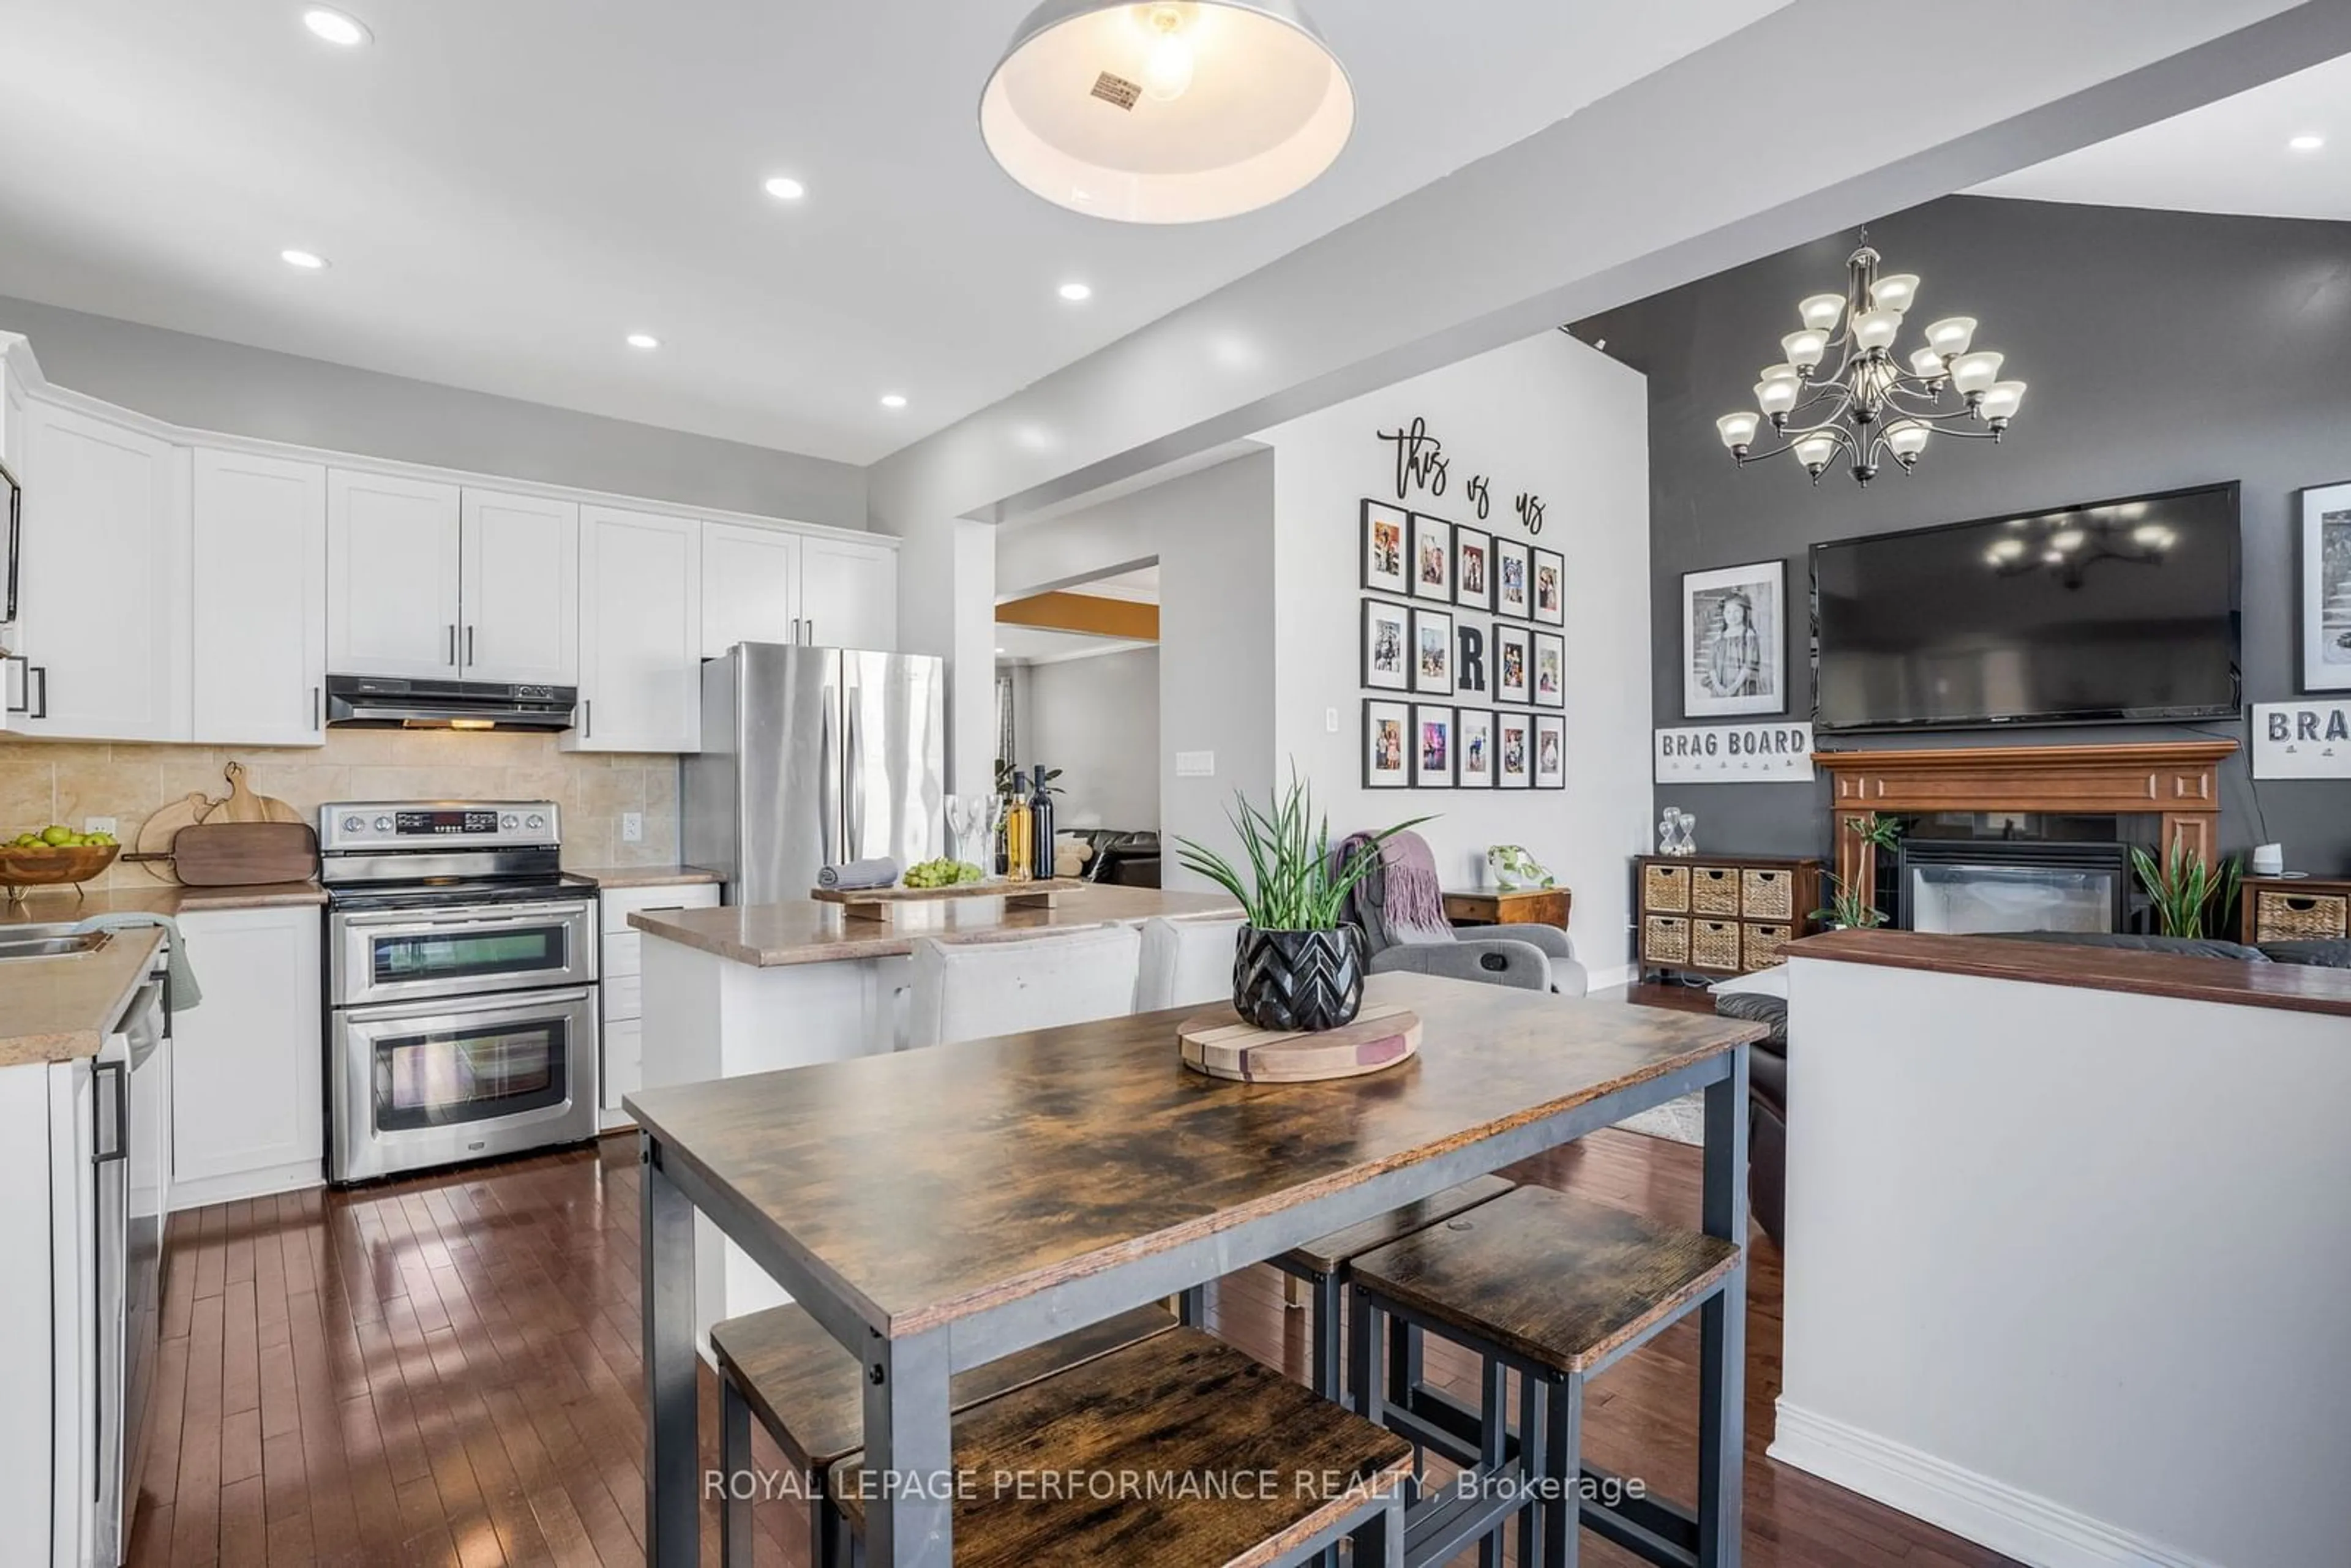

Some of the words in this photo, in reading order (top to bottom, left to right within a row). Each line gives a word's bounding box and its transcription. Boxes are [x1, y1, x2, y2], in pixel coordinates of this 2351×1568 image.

[1377, 416, 1450, 499] this
[1467, 475, 1490, 520] is
[1516, 492, 1547, 536] us
[1458, 625, 1485, 691] R
[1663, 732, 1718, 757] BRAG
[1728, 729, 1805, 756] BOARD
